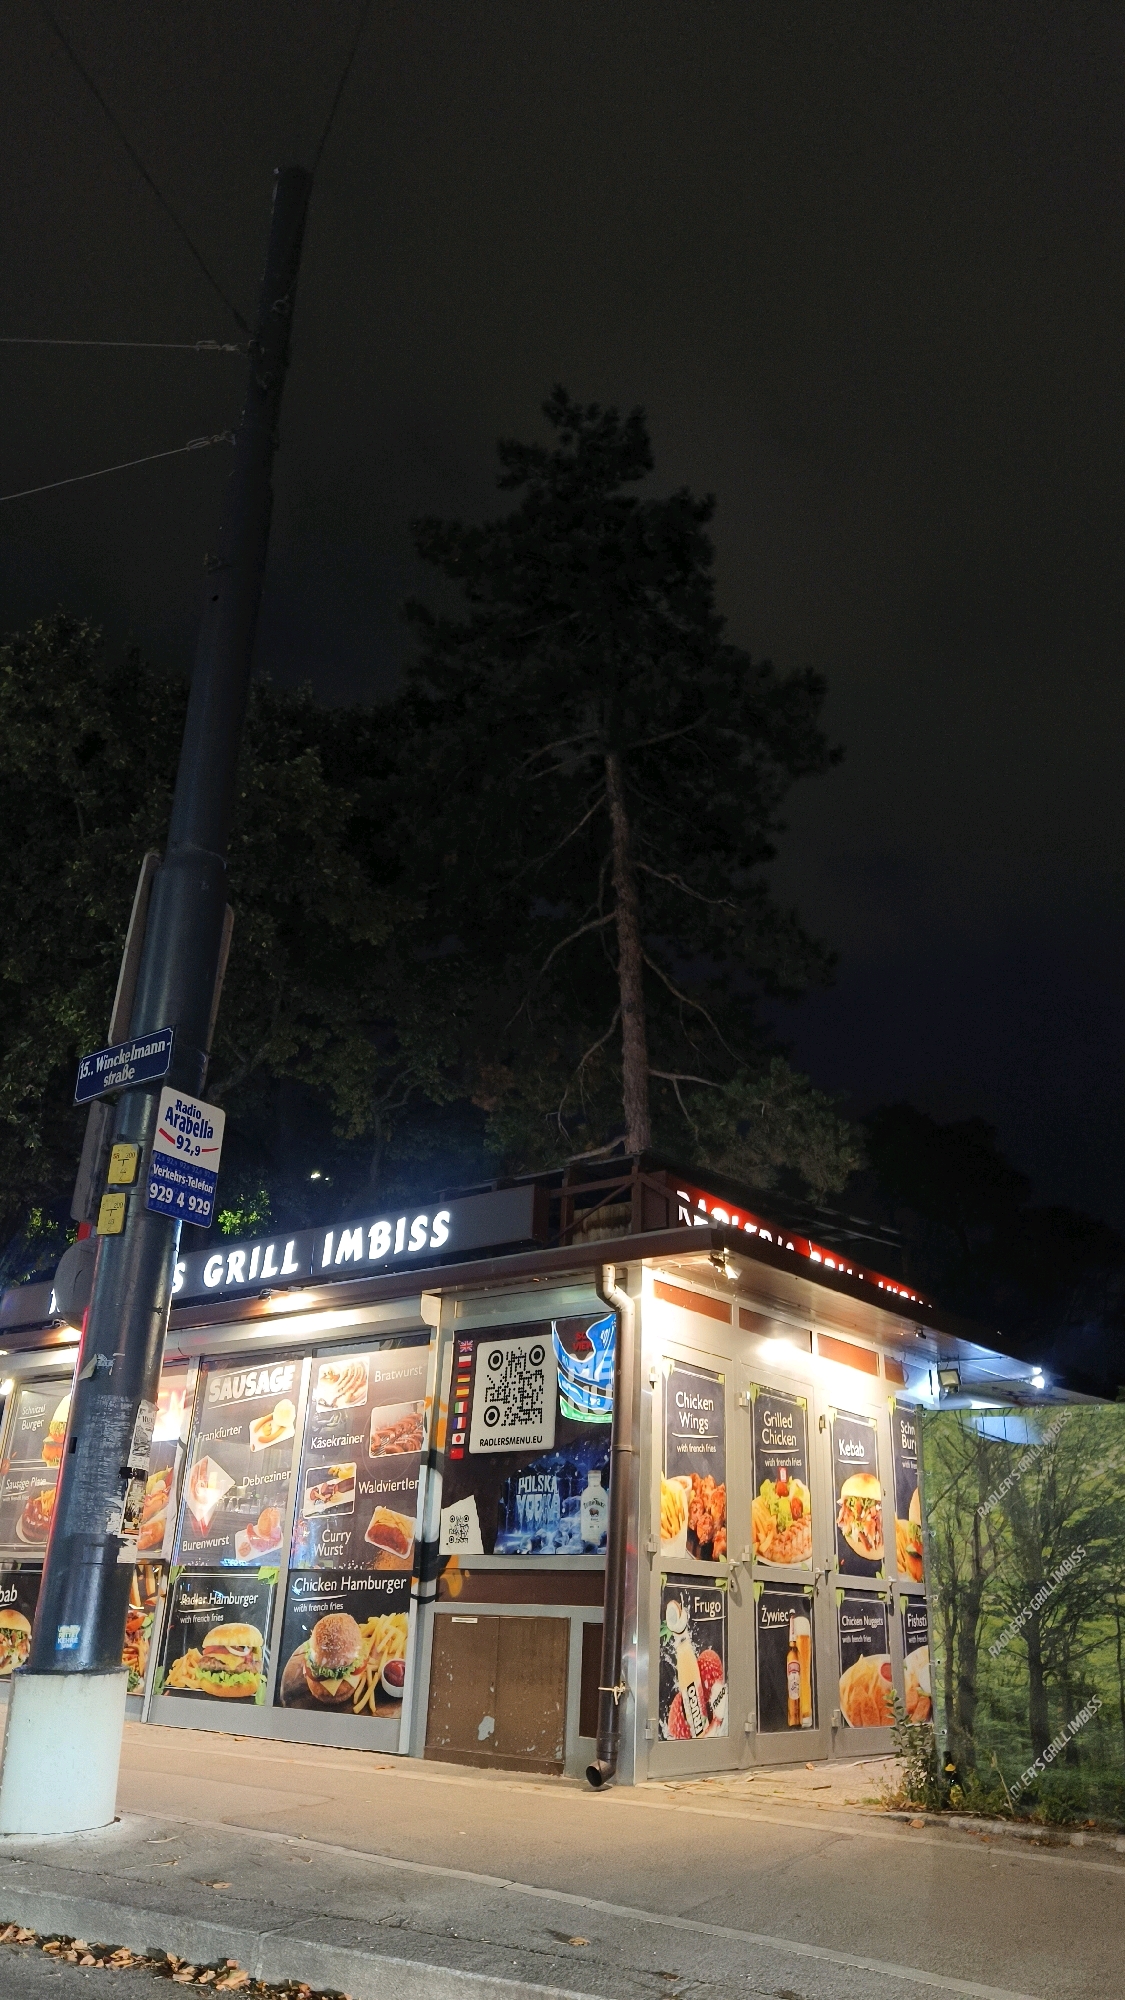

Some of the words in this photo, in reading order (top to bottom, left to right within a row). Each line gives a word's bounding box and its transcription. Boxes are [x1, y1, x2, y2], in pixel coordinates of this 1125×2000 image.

[96, 1041, 170, 1073] Winckelmann-
[103, 1064, 135, 1087] straße
[175, 1099, 201, 1119] Radio
[165, 1106, 213, 1138] Arabella
[176, 1134, 200, 1156] 92,9
[153, 1164, 213, 1193] Verkehrs-Telefon
[150, 1183, 173, 1203] 929
[176, 1192, 185, 1207] 4
[188, 1196, 210, 1215] 929
[203, 1240, 299, 1288] GRILL
[321, 1210, 451, 1268] IMBISS
[374, 1366, 423, 1382] Bratwurst
[208, 1365, 296, 1403] SAUSAGE
[675, 1391, 714, 1411] Chicken
[21, 1419, 45, 1431] Burger
[679, 1411, 709, 1434] Wings
[763, 1410, 793, 1429] Grilled
[197, 1426, 242, 1443] Frankfurter
[311, 1434, 364, 1449] Käsekrainer
[479, 1435, 543, 1447] RADLERSMENU.EU
[761, 1428, 797, 1446] Chicken
[676, 1443, 688, 1453] with
[689, 1443, 705, 1453] french
[706, 1443, 717, 1453] fries
[838, 1438, 865, 1457] Kebab
[764, 1457, 776, 1467] with
[776, 1457, 792, 1467] french
[792, 1457, 802, 1467] fries
[977, 1469, 1020, 1519] RADLER'S
[1018, 1441, 1045, 1473] GRILL
[1041, 1407, 1073, 1446] IMBISS
[5, 1479, 30, 1491] Sausage
[242, 1470, 292, 1488] Debreziner
[358, 1477, 419, 1494] Waldviertler
[518, 1474, 559, 1494] POLSKA
[182, 1536, 229, 1551] Burenwurst
[322, 1529, 351, 1545] Curry
[313, 1543, 343, 1556] Wurst
[294, 1576, 337, 1592] Chicken
[341, 1575, 407, 1594] Hamburger
[208, 1592, 259, 1608] Hamburger
[293, 1604, 307, 1613] with
[308, 1603, 328, 1612] french
[329, 1602, 344, 1611] fries
[694, 1596, 721, 1617] Frugo
[988, 1606, 1033, 1659] RADLER'S
[1030, 1580, 1057, 1611] GRILL
[1051, 1544, 1087, 1584] IMBISS
[180, 1615, 191, 1624] with
[193, 1614, 210, 1623] french
[211, 1613, 224, 1622] fries
[761, 1606, 789, 1626] Żywiec
[841, 1615, 863, 1626] Chicken
[863, 1615, 883, 1629] Nuggets
[1042, 1730, 1072, 1763] GRILL
[1067, 1694, 1103, 1735] IMBISS
